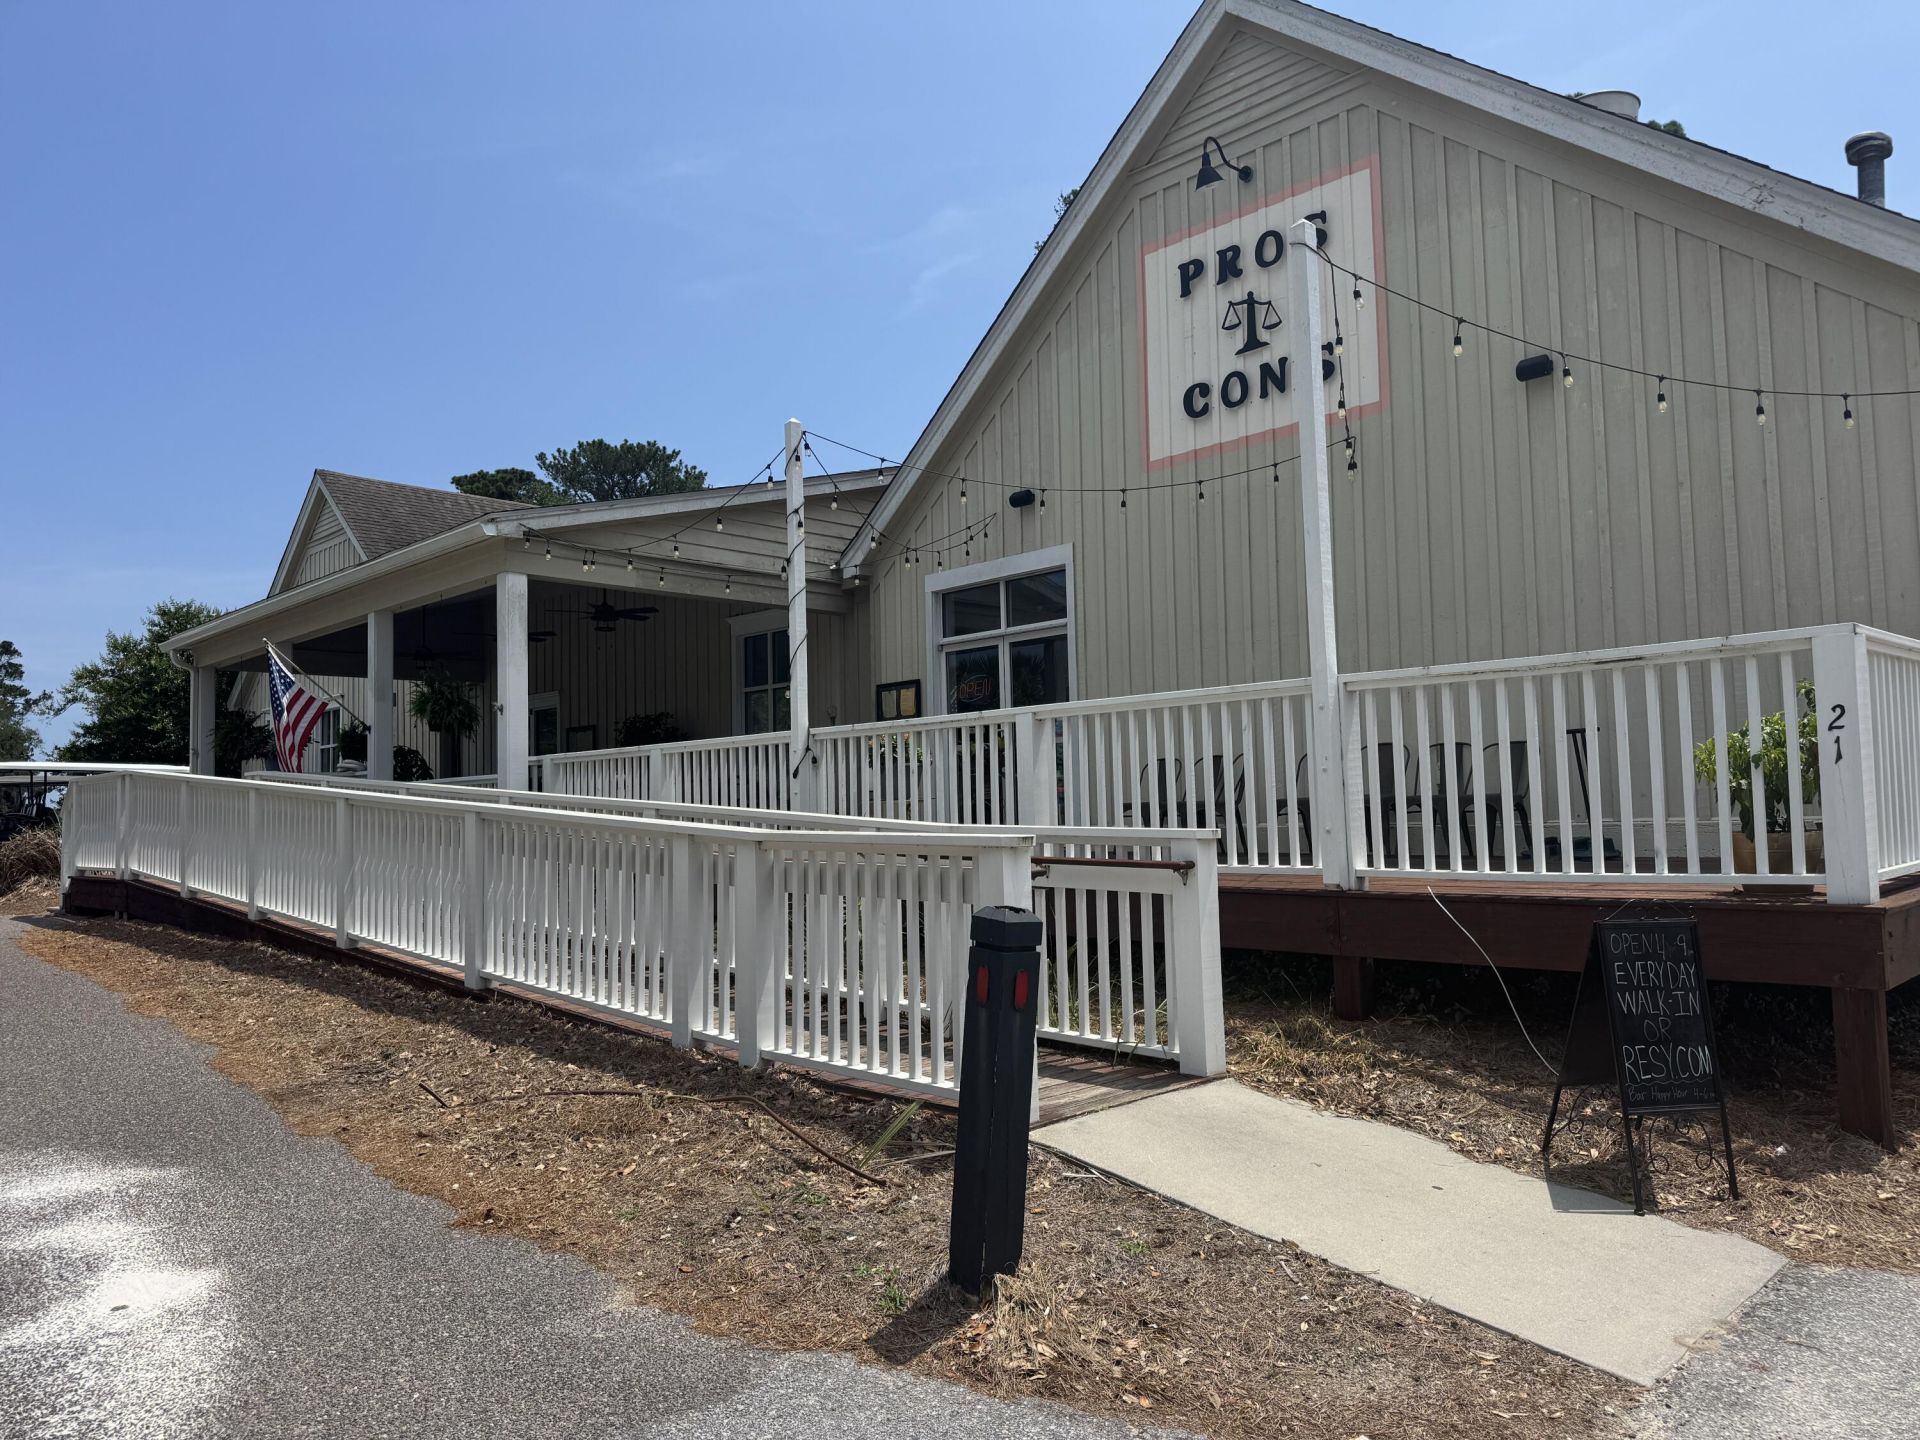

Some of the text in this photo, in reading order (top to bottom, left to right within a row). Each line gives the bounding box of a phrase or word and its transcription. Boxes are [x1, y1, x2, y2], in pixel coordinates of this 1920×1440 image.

[959, 677, 992, 698] OPEN
[1610, 933, 1653, 956] OPEN
[1617, 989, 1700, 1016] WALK-IN
[1643, 1017, 1673, 1042] OR
[1622, 1042, 1713, 1083] RESY.COM
